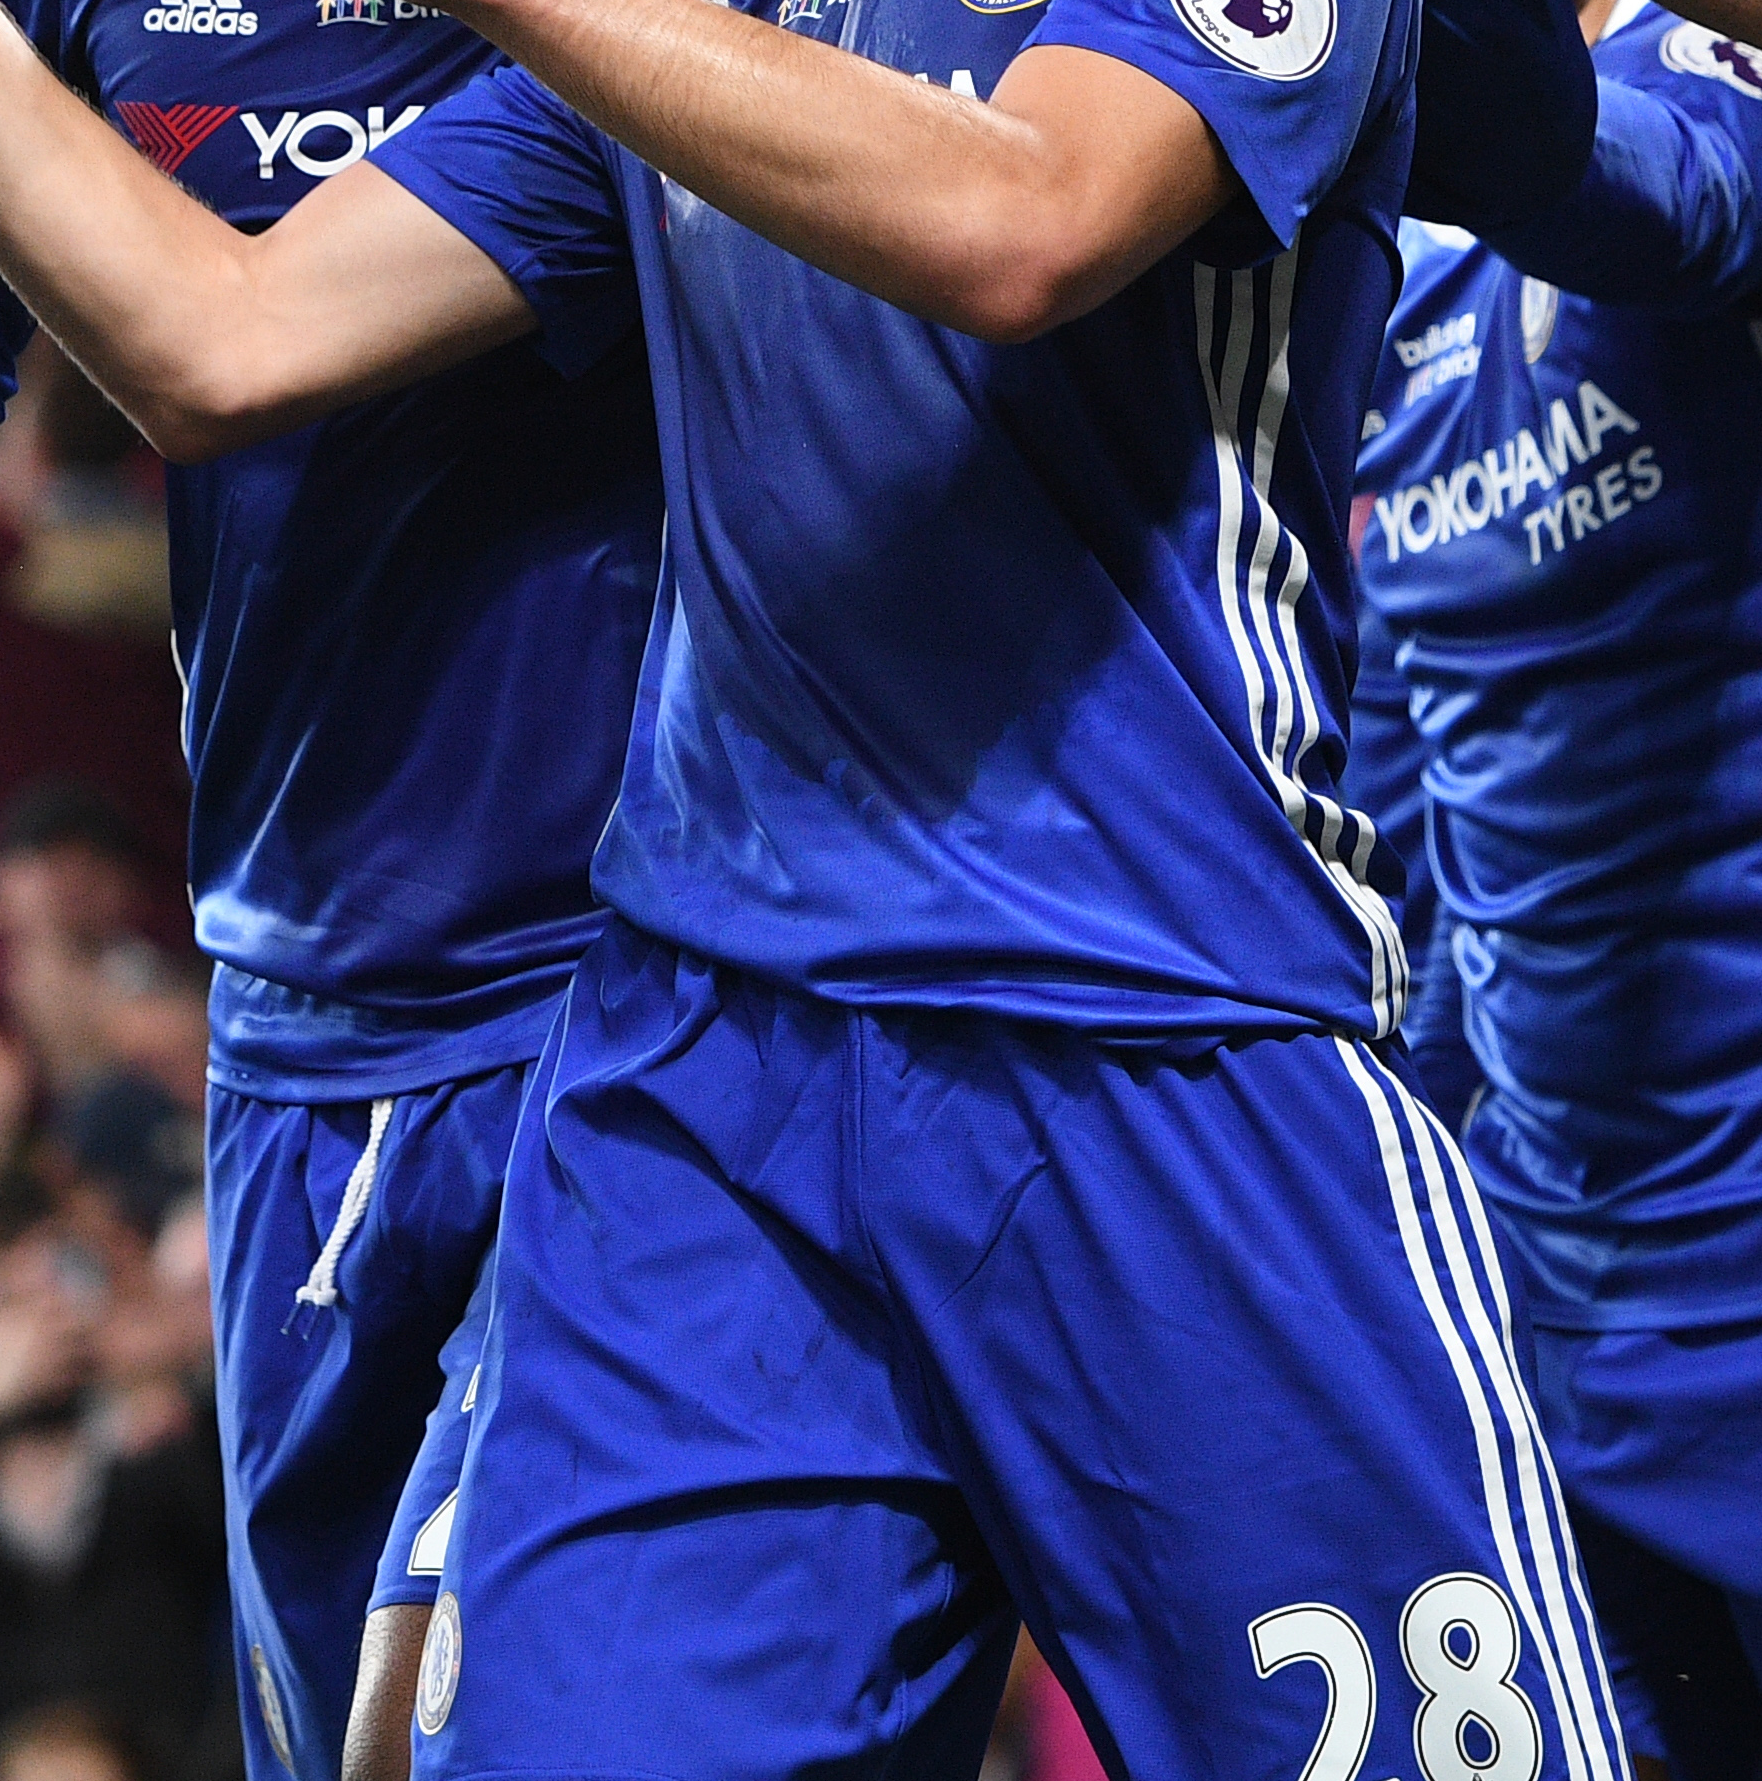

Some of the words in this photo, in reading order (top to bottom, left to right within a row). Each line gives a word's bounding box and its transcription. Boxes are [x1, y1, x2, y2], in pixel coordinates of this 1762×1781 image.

[142, 4, 259, 36] adidas
[1523, 444, 1664, 567] TYRES
[1246, 1570, 1544, 1781] 28
